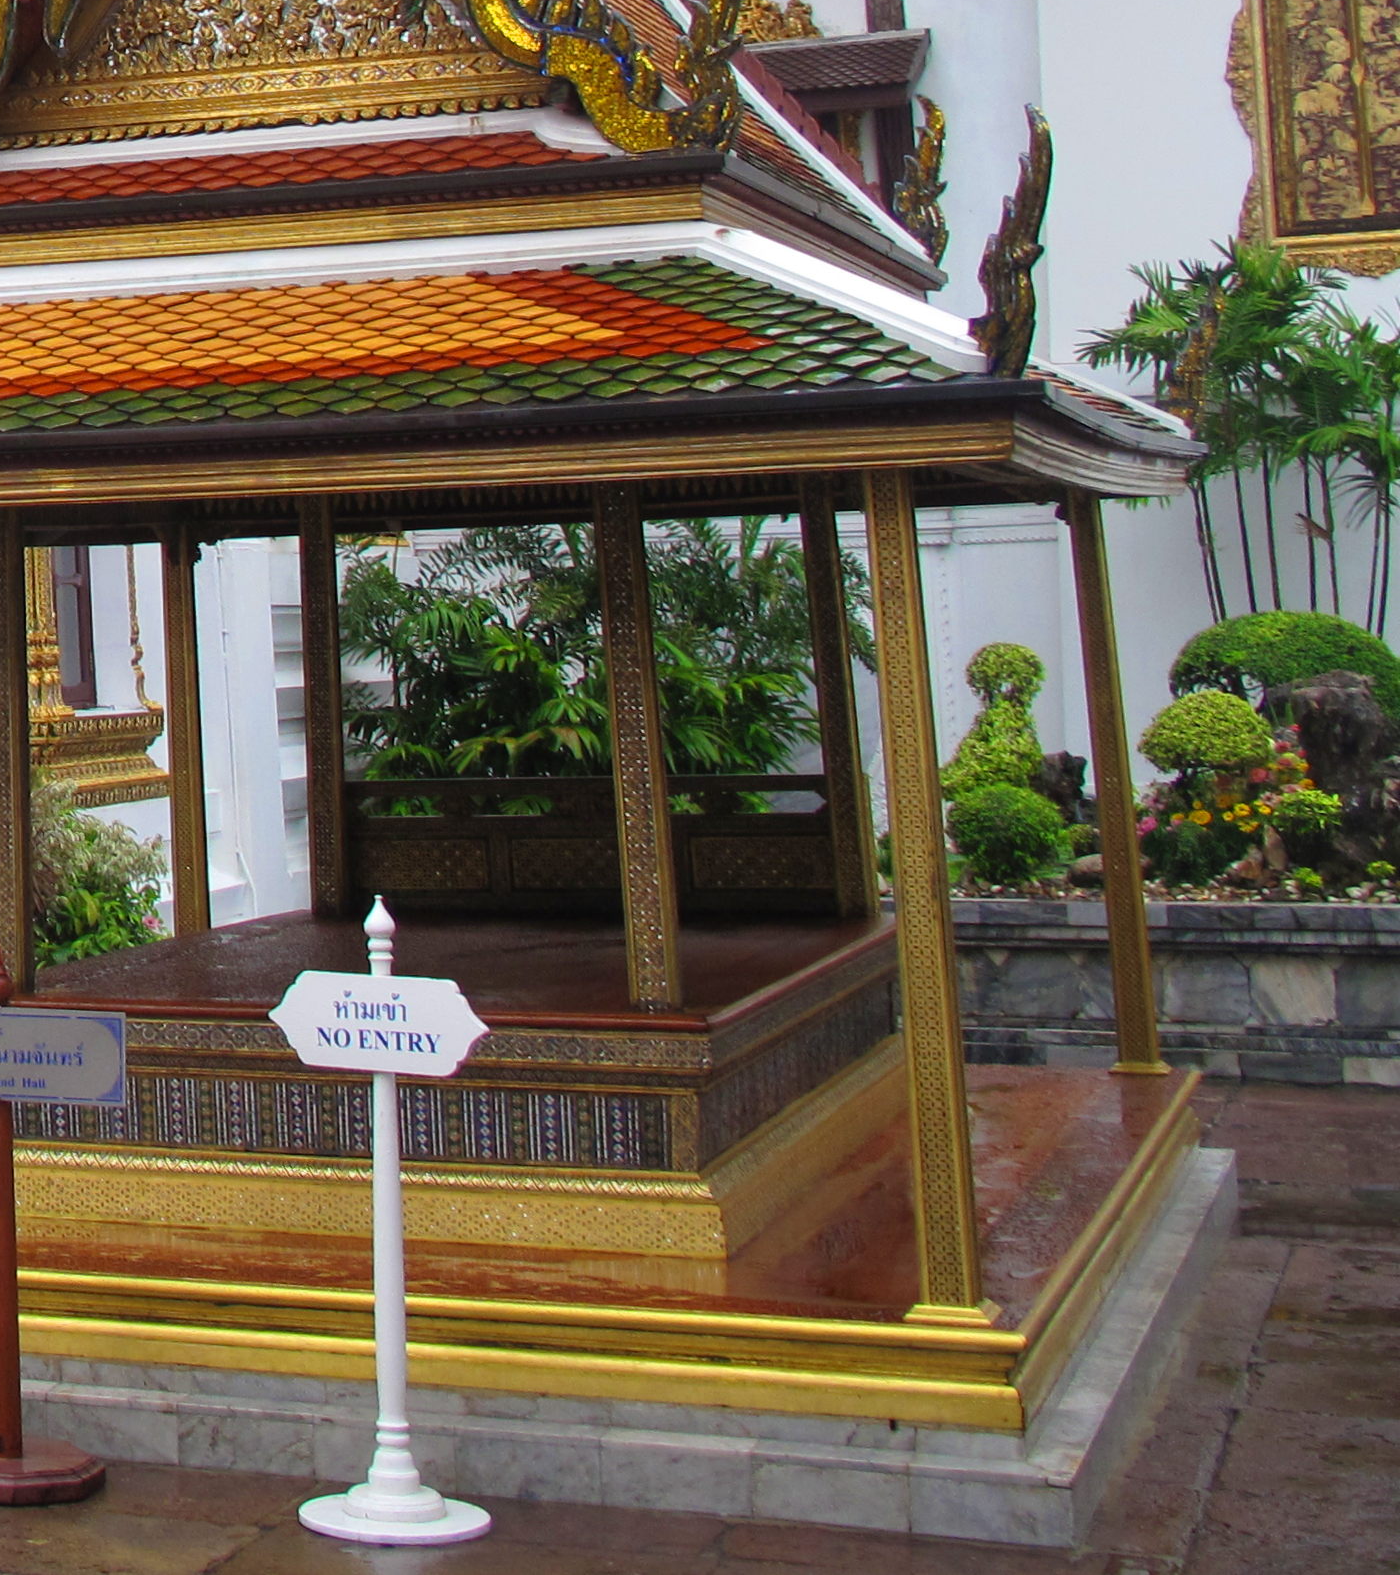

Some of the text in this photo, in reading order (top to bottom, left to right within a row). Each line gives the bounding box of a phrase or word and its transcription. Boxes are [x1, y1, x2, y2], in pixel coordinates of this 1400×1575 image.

[333, 990, 407, 1022] ห้ามเข้า
[317, 1027, 440, 1053] NO ENTRY
[22, 1077, 46, 1088] Hall
